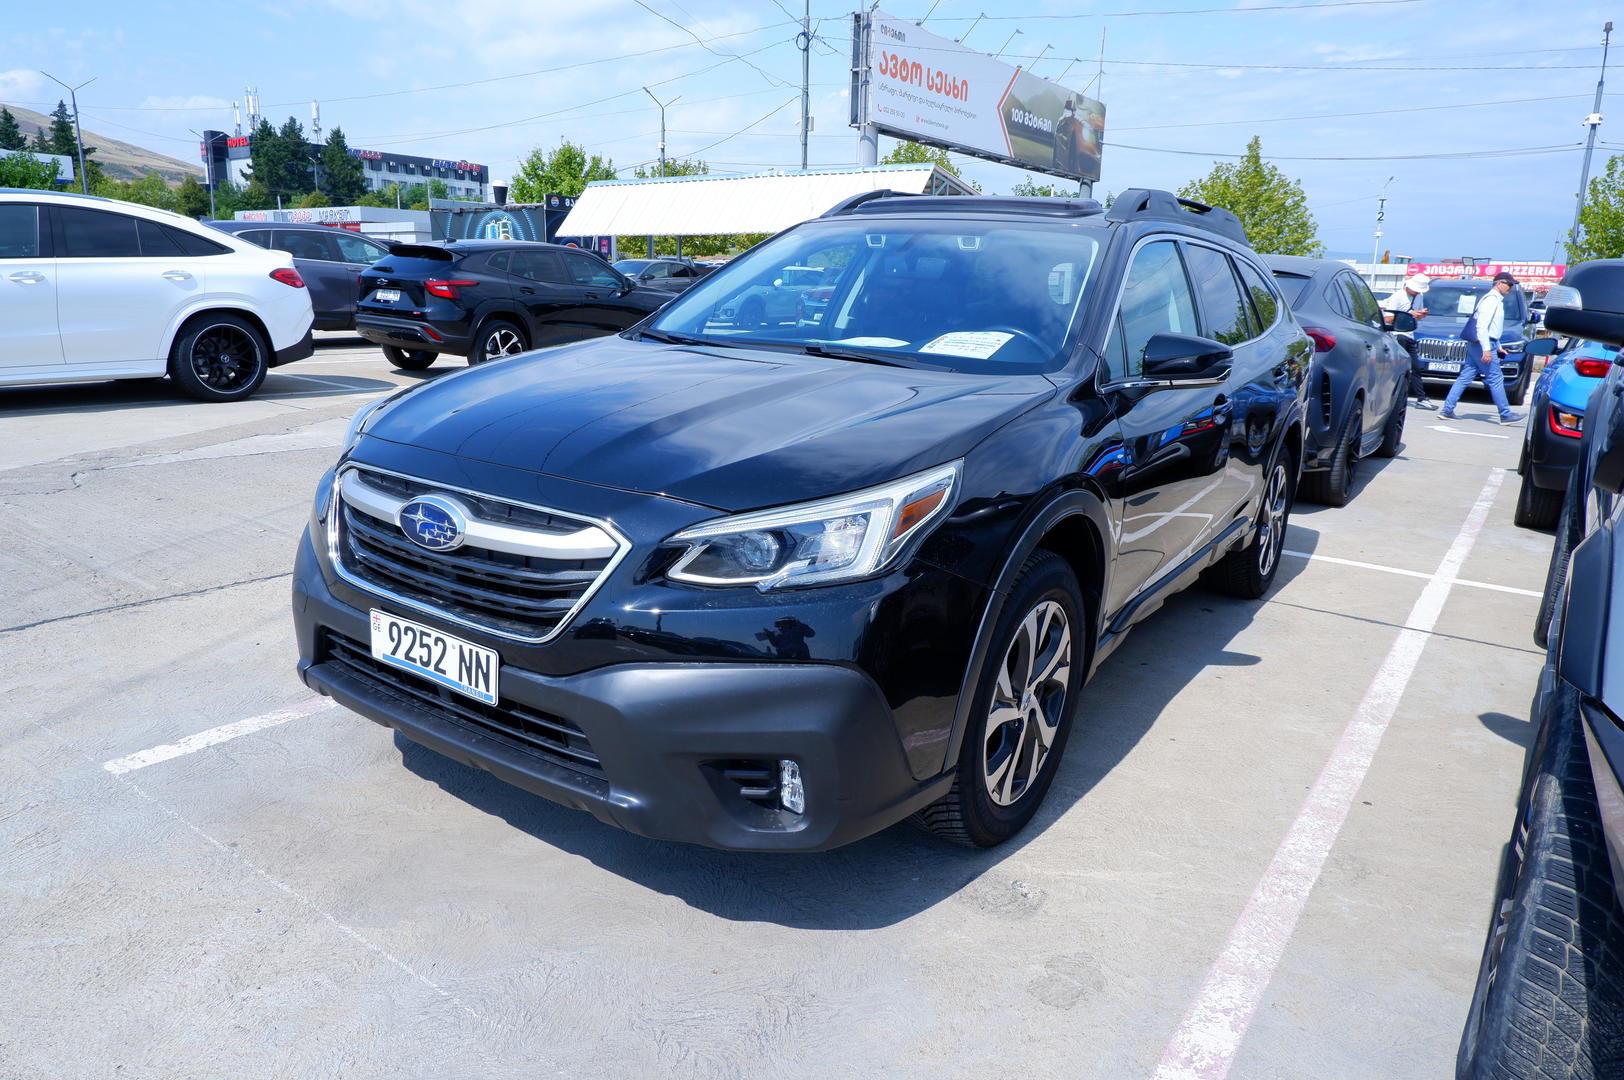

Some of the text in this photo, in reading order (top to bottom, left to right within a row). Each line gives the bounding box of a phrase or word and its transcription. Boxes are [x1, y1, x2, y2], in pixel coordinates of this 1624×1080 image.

[879, 50, 969, 102] ავტო სესხი
[1011, 108, 1024, 124] 100
[227, 137, 249, 147] HOTEL
[1501, 265, 1557, 276] PIZZERIA
[373, 623, 381, 632] GE
[388, 621, 491, 693] 9252 NN
